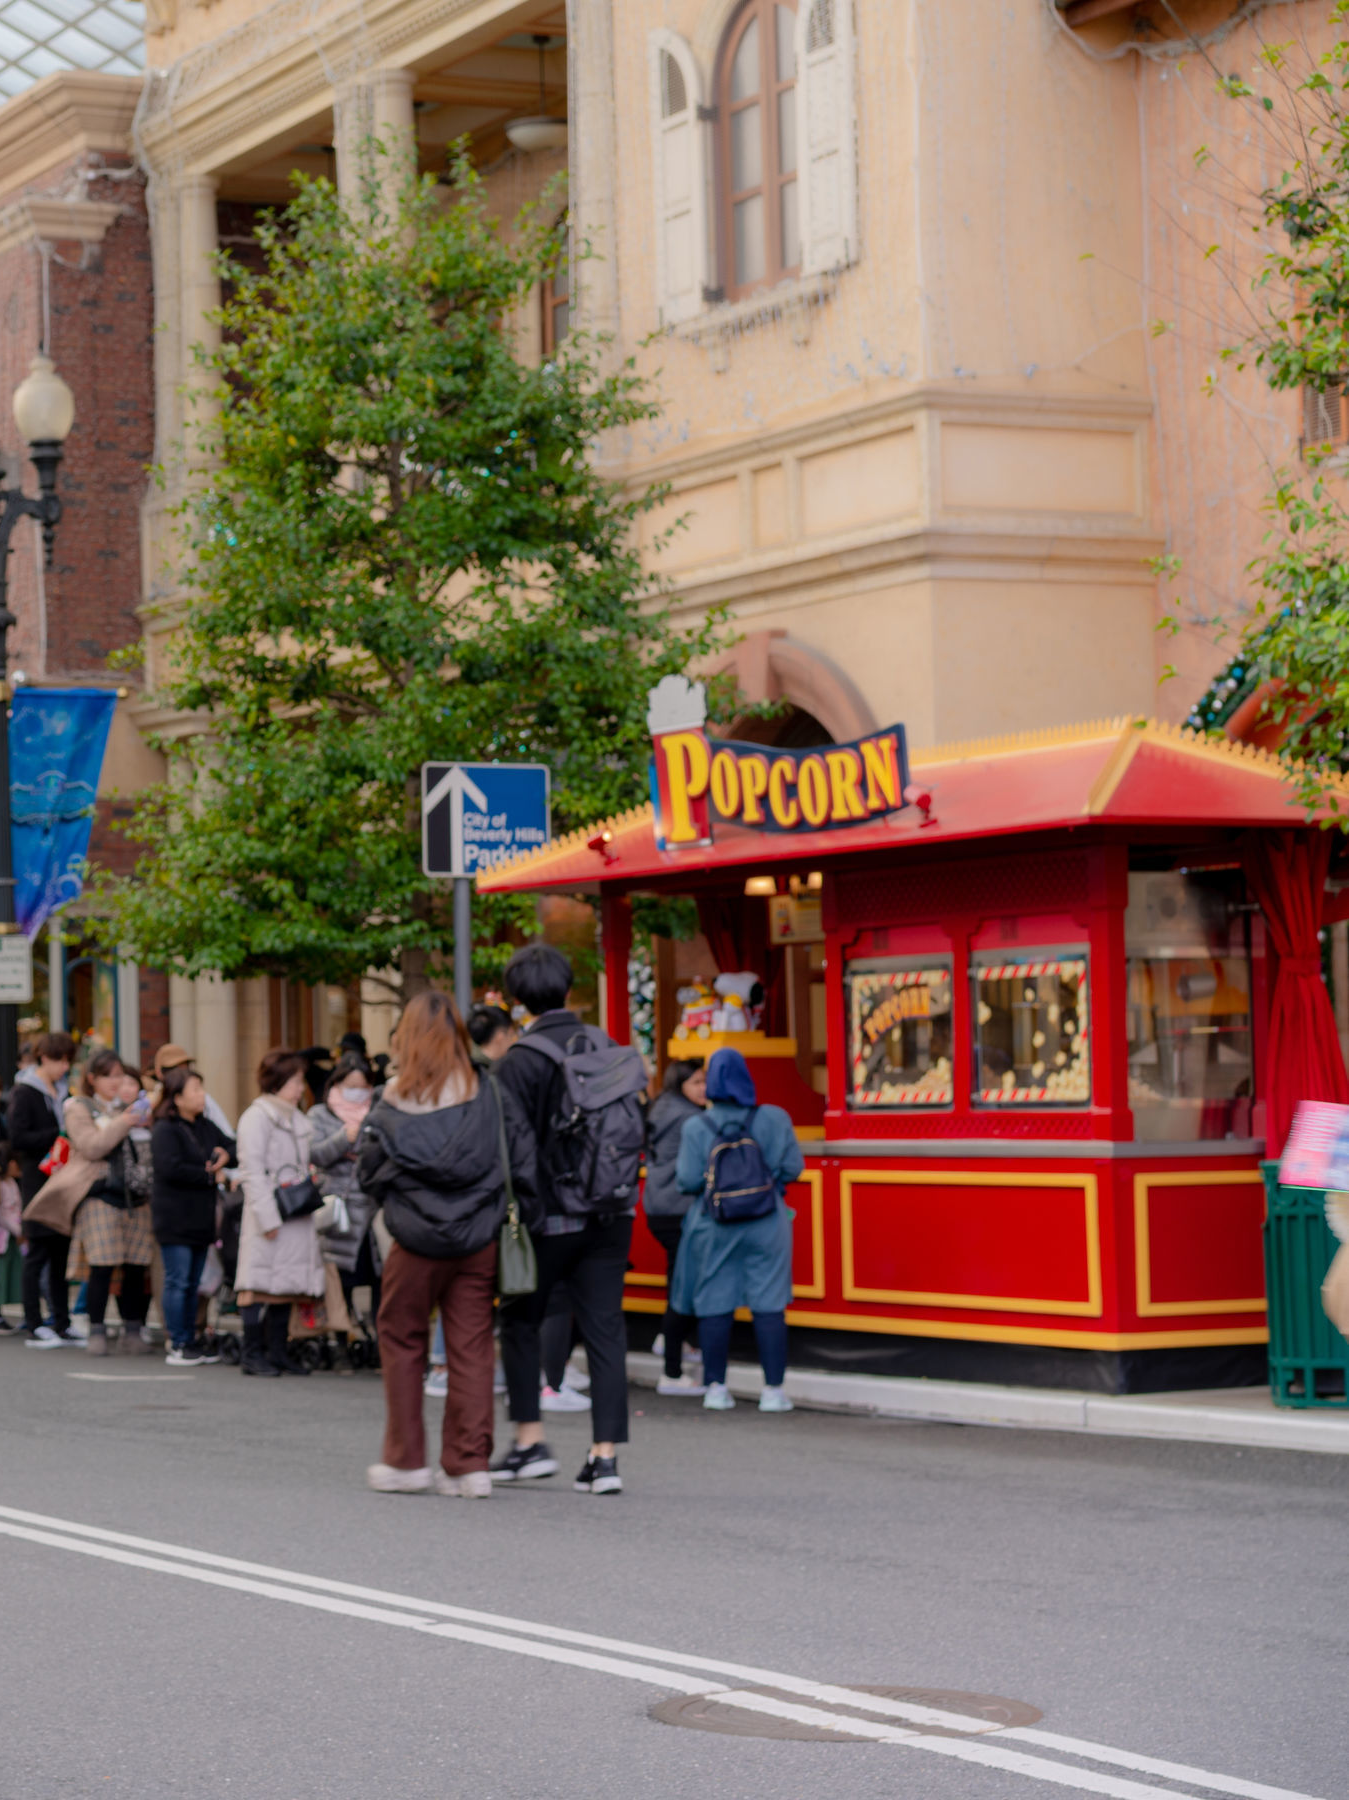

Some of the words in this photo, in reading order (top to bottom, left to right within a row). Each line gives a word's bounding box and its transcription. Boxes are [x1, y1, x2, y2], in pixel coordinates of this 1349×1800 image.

[464, 812, 490, 828] City
[491, 812, 507, 827] of
[464, 829, 513, 845] Beverly
[515, 827, 545, 842] Hills
